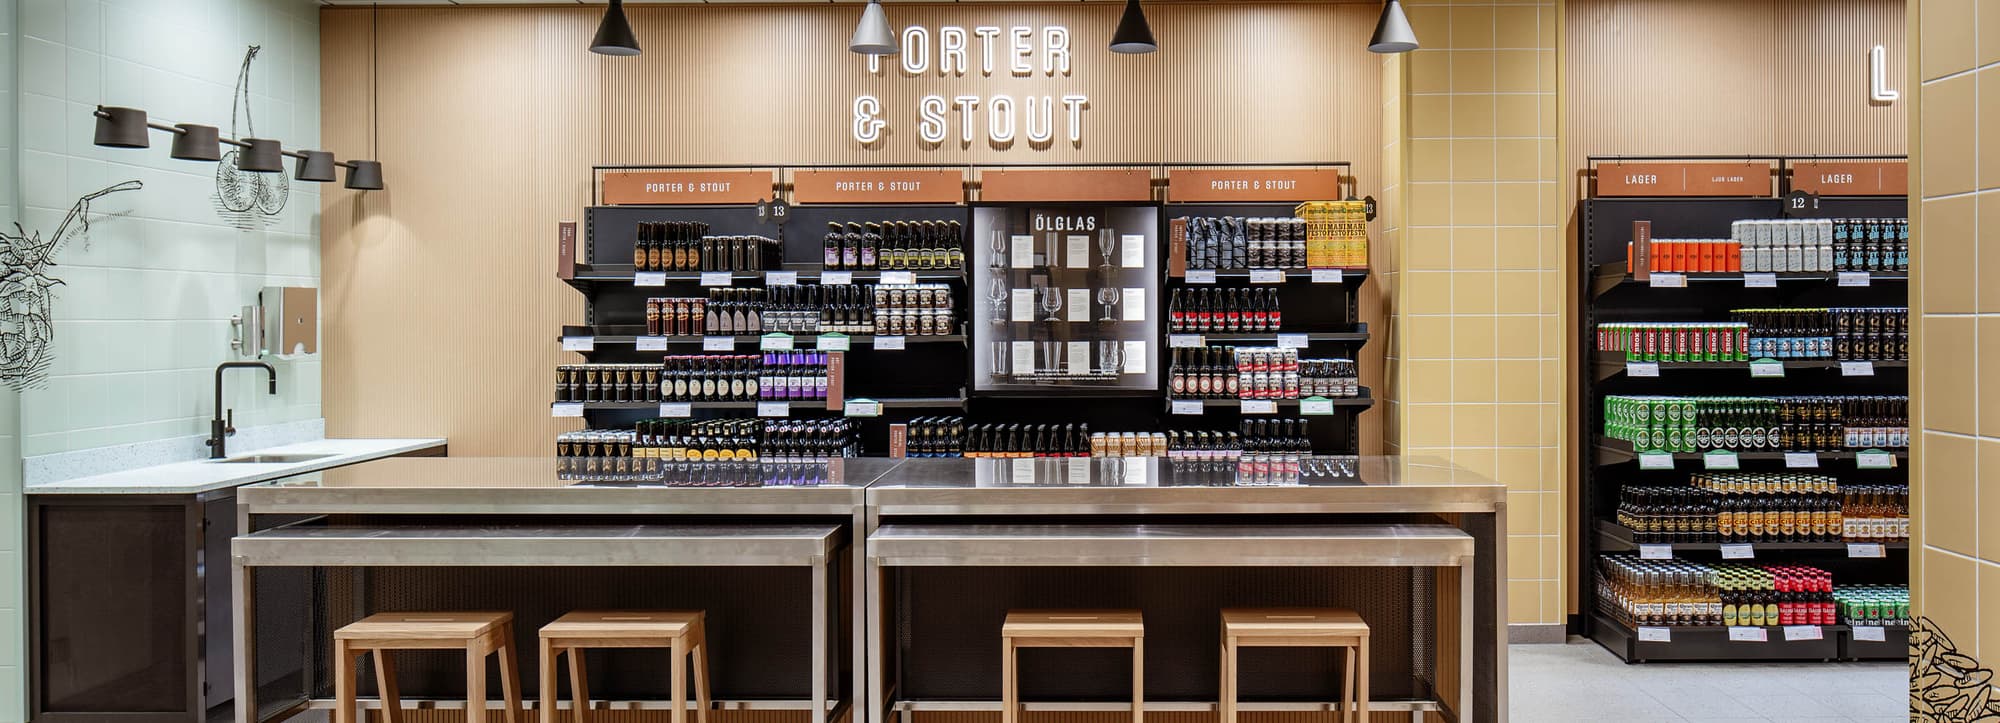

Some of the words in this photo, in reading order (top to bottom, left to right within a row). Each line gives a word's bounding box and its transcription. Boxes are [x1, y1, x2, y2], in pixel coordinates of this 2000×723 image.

[854, 95, 886, 143] &
[920, 95, 1087, 143] STOUT
[1625, 175, 1657, 185] LAGER
[1821, 174, 1853, 184] LAGER
[645, 183, 683, 193] PORTER
[688, 183, 695, 192] &
[700, 182, 731, 192] STOUT
[835, 181, 873, 191] PORTER
[878, 181, 885, 191] &
[890, 181, 921, 191] STOUT
[1211, 180, 1249, 190] PORTER
[1254, 180, 1260, 190] &
[1265, 180, 1297, 190] STOUT
[1791, 197, 1806, 209] 12
[773, 205, 785, 217] 13
[1035, 213, 1096, 231] ÖLGLAS
